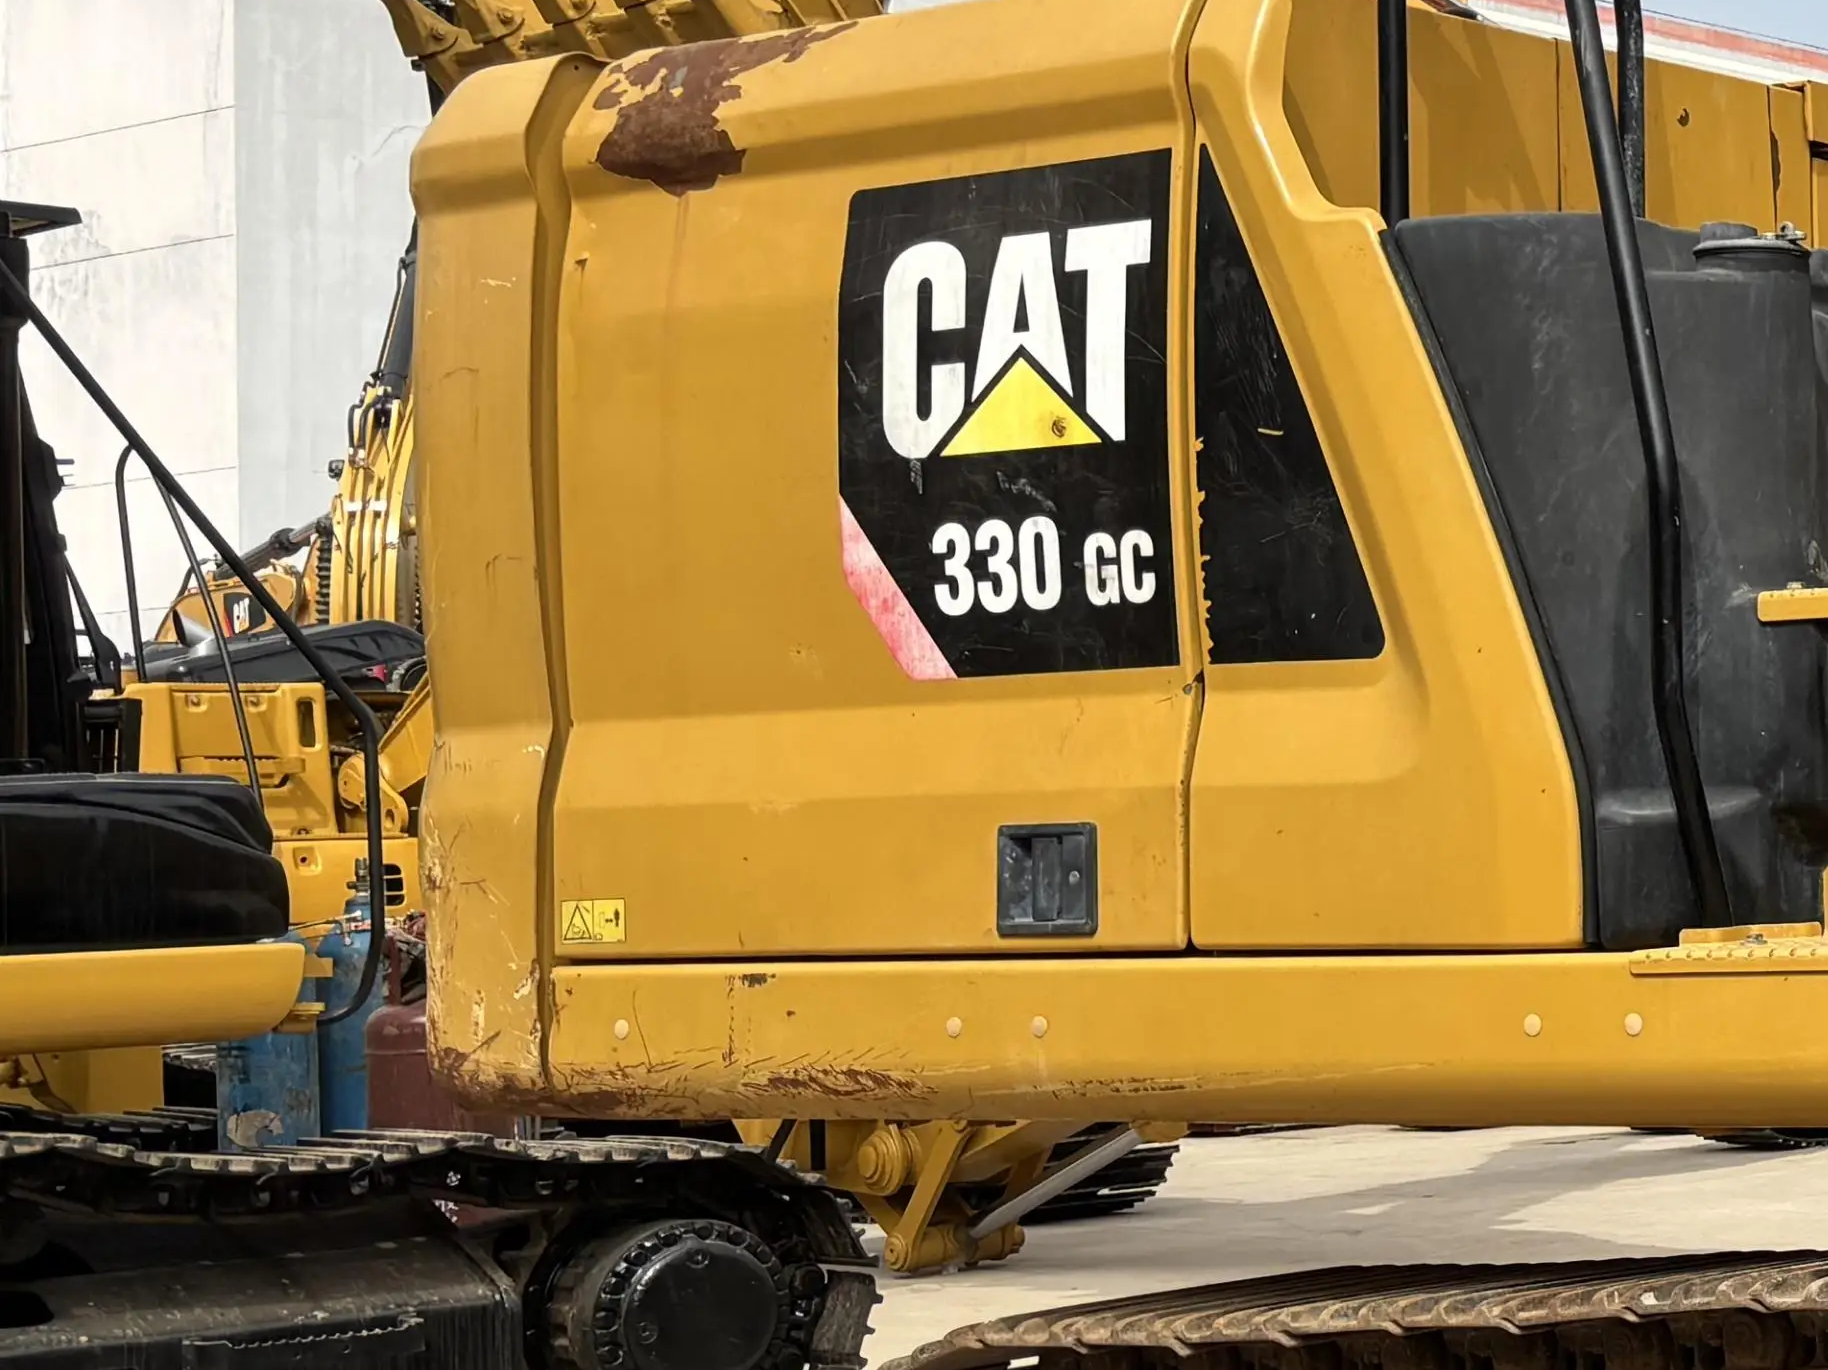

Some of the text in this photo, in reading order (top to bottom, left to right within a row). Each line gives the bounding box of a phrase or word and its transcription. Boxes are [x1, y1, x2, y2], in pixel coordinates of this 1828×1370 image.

[883, 219, 1152, 459] CAT
[233, 597, 250, 634] CAT
[932, 516, 1156, 616] 330 GC
